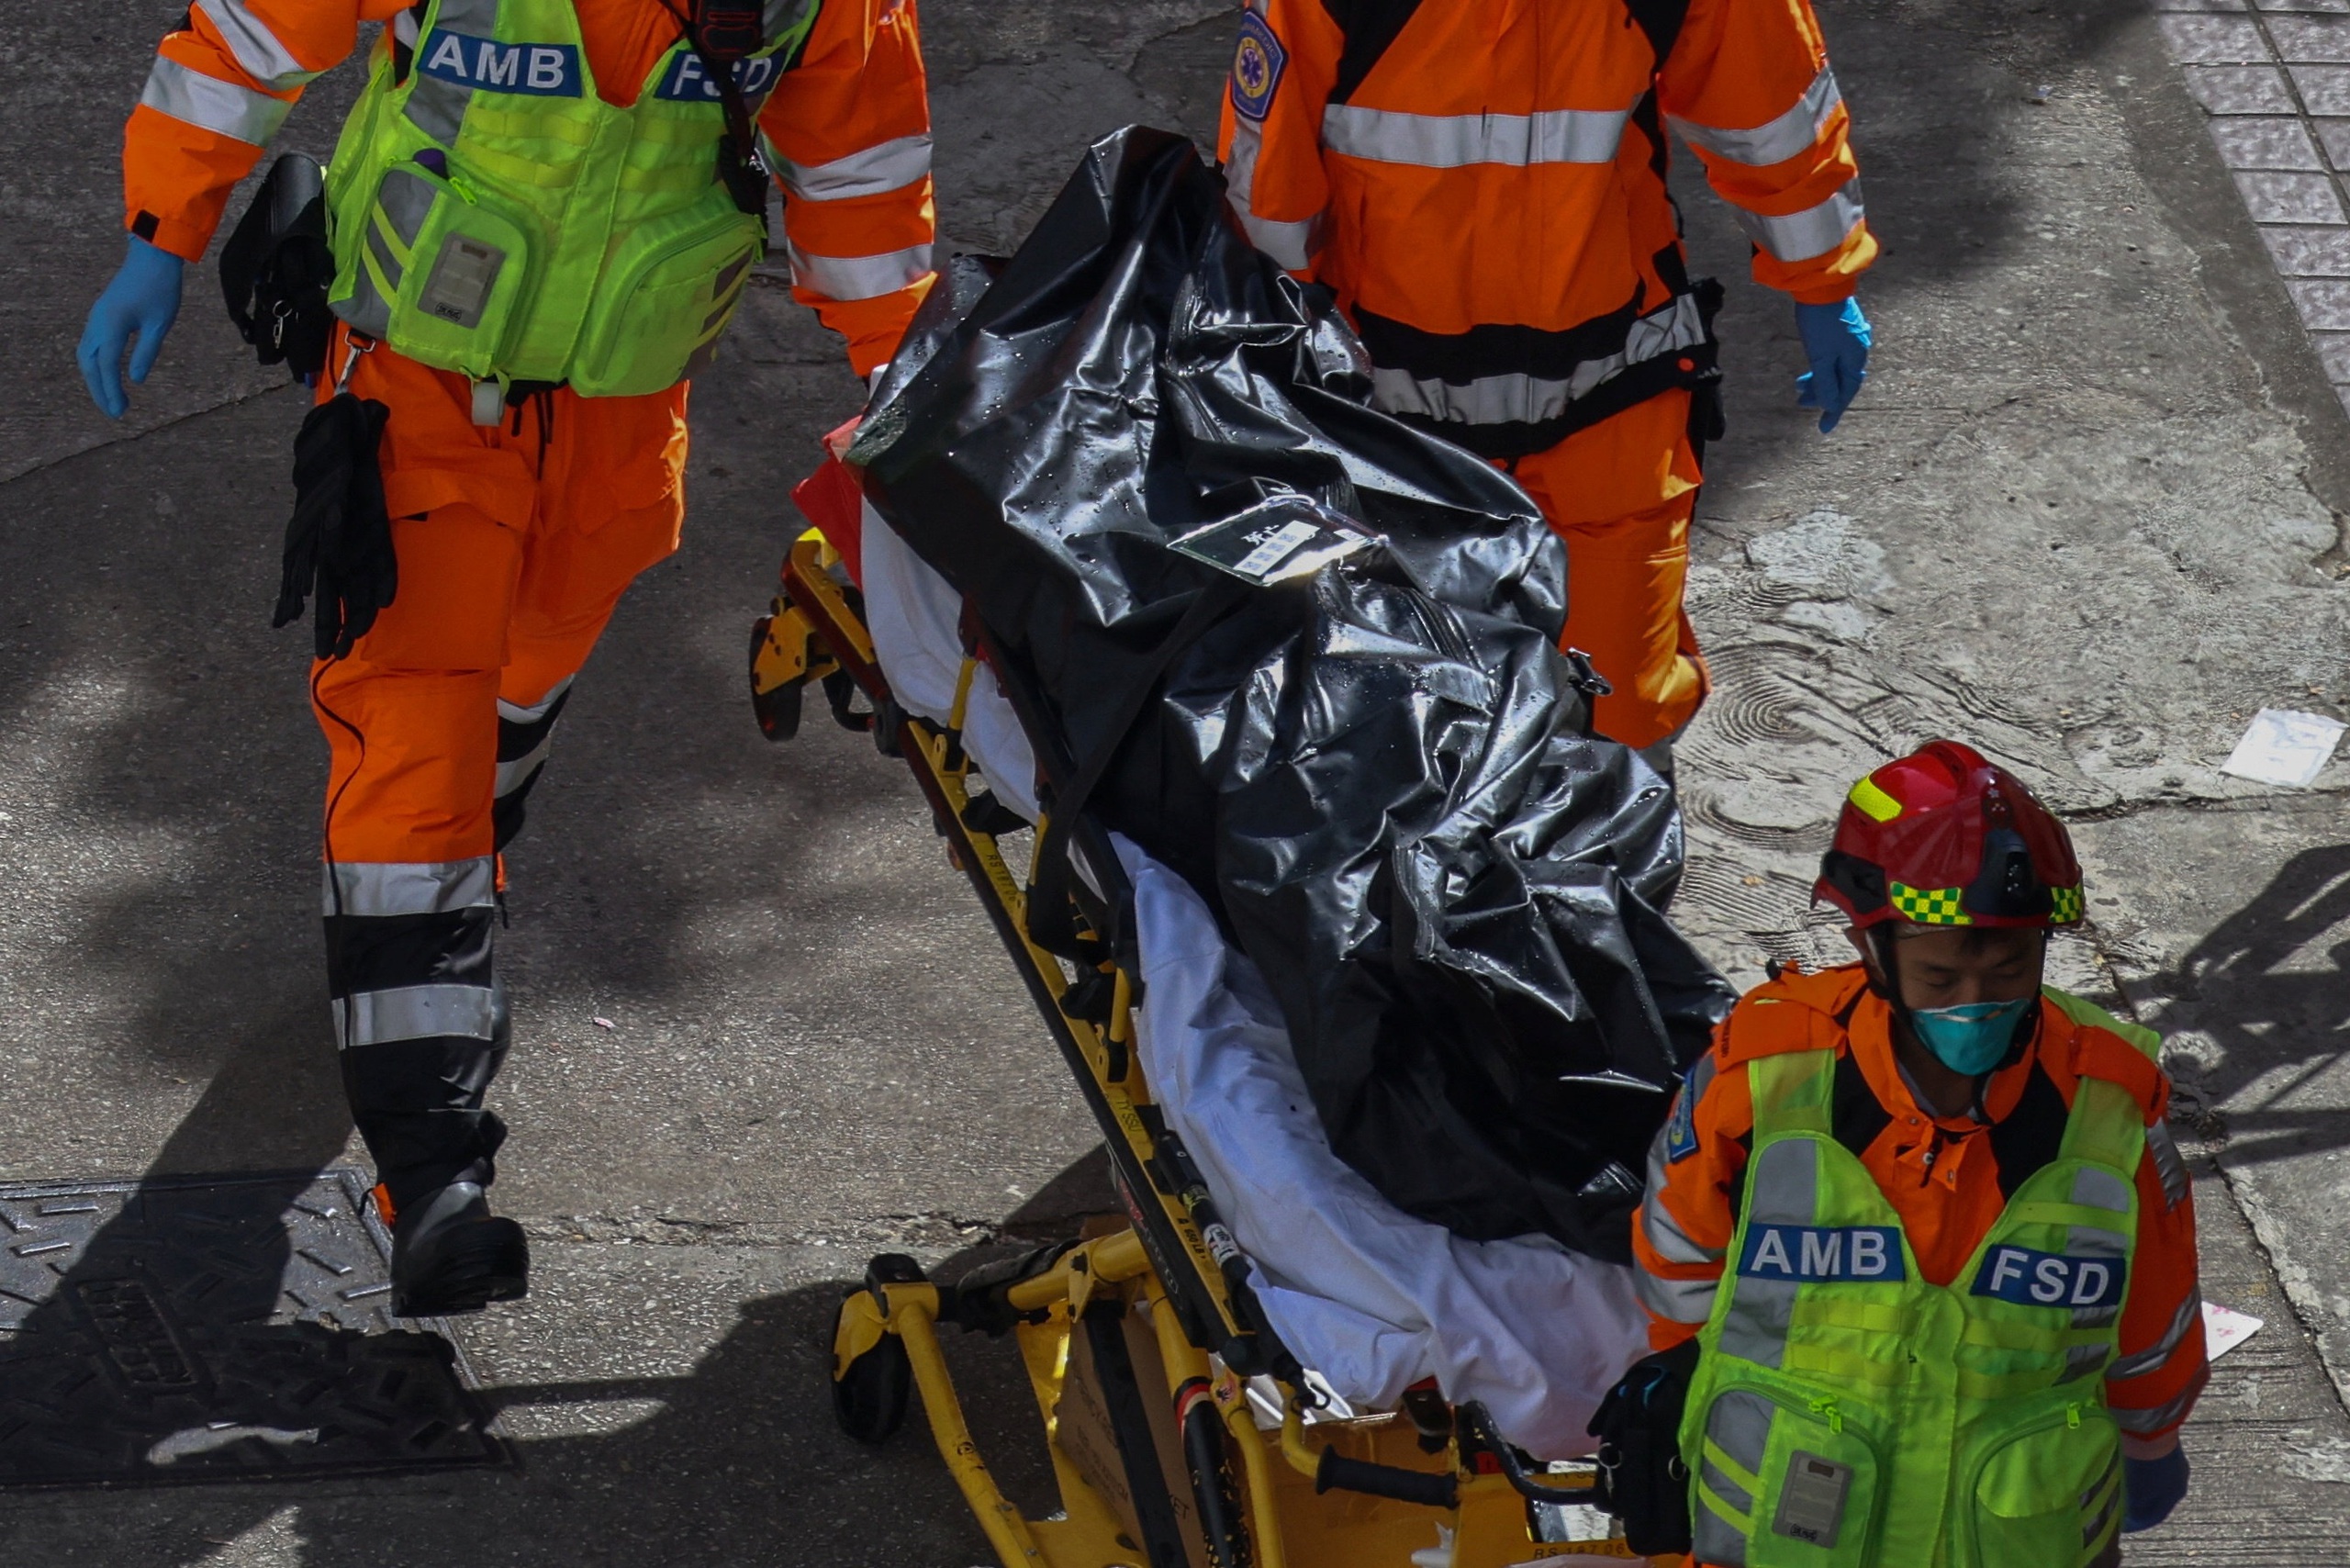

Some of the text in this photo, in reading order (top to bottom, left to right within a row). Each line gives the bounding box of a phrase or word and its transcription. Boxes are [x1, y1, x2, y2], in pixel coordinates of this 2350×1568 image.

[428, 34, 565, 89] AMB
[1751, 1228, 1887, 1276] AMB
[1988, 1249, 2110, 1305] FSD
